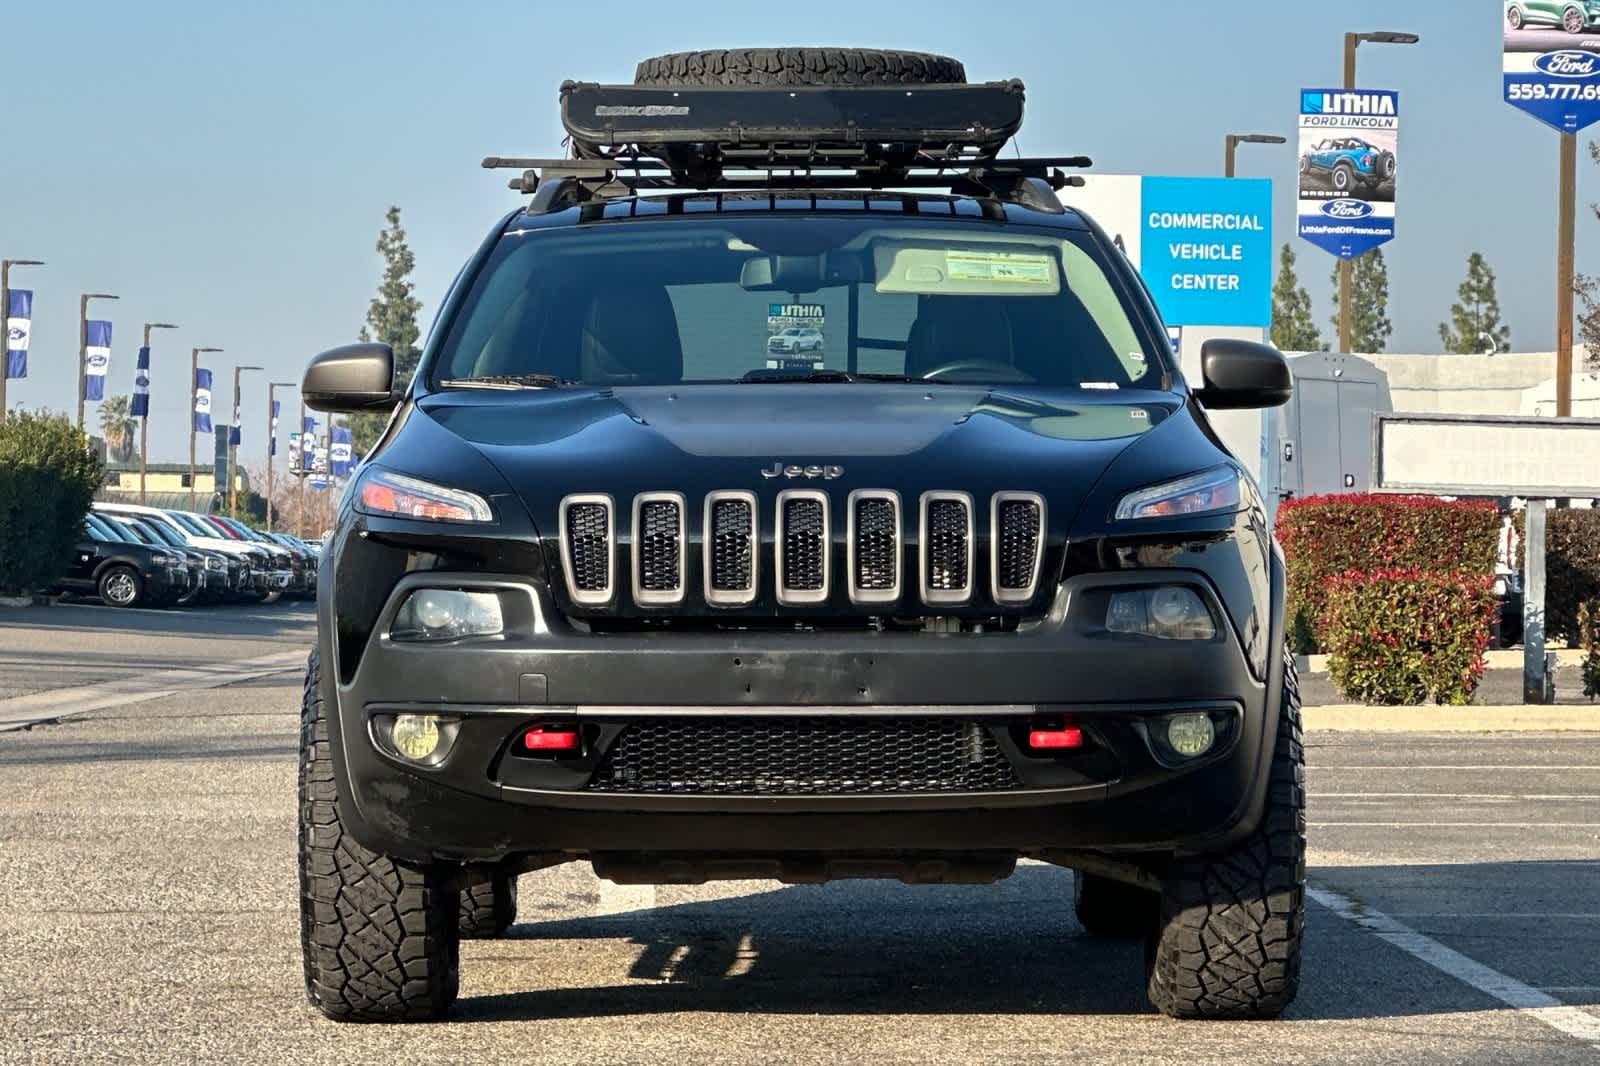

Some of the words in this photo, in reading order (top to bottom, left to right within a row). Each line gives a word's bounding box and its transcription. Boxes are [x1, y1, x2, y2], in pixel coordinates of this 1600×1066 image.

[1547, 54, 1595, 73] Ford
[1322, 92, 1395, 114] LITHIA
[1304, 116, 1338, 126] FORD
[1340, 117, 1394, 128] LINCOLN
[1330, 200, 1364, 216] Ford
[1149, 213, 1264, 230] COMMERCIAL
[1169, 243, 1242, 260] VEHICLE
[1171, 274, 1239, 290] CENTER
[781, 305, 823, 317] LITHIA
[761, 462, 844, 480] Jeep
